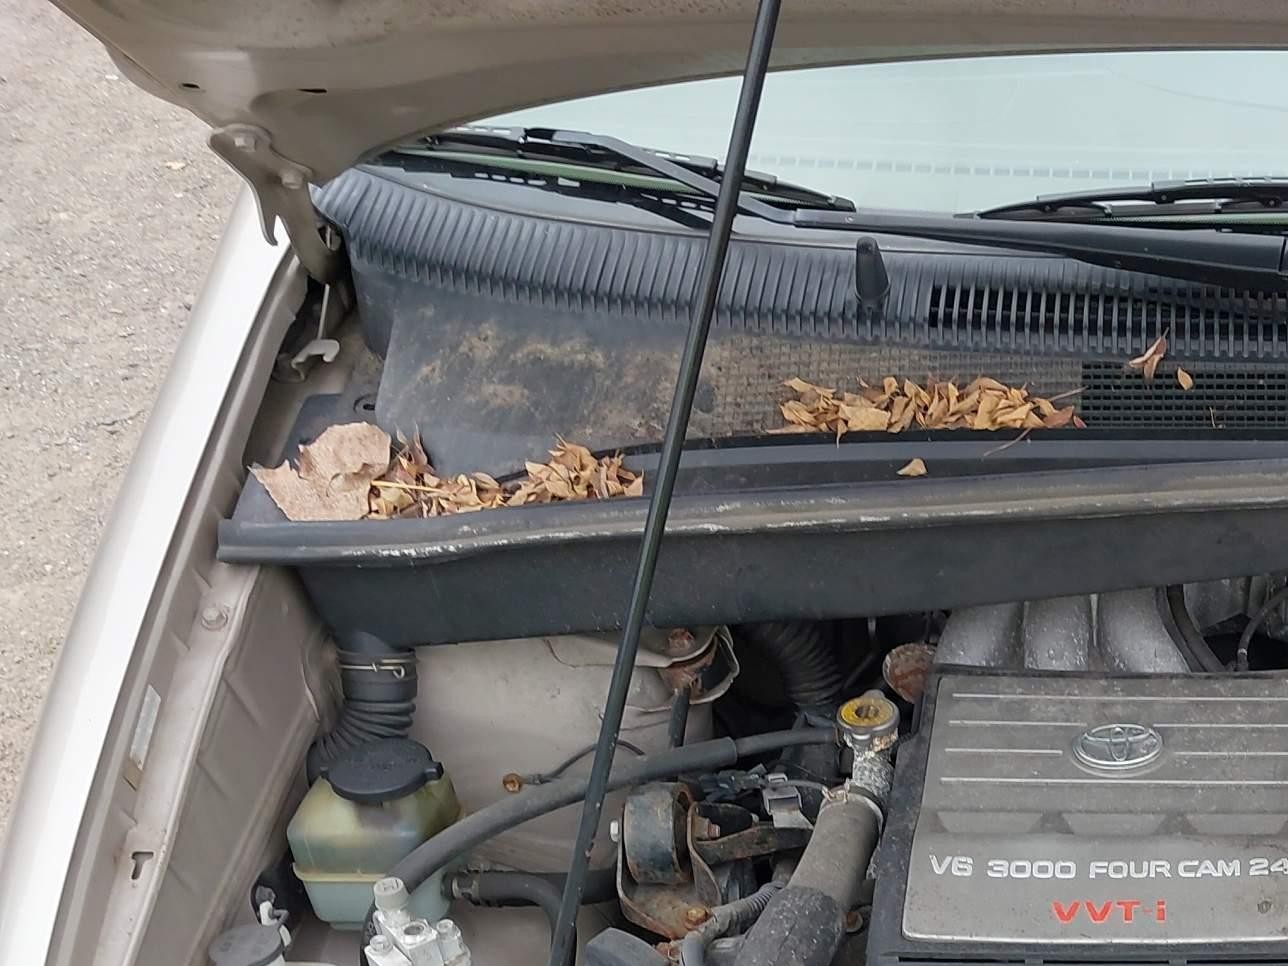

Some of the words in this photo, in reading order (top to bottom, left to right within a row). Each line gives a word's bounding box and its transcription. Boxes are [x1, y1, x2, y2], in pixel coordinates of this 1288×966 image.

[928, 855, 974, 876] V6
[986, 859, 1077, 879] 3000
[1089, 859, 1172, 879] FOUR
[1177, 858, 1241, 877] CAM
[1051, 899, 1167, 924] VVT-i
